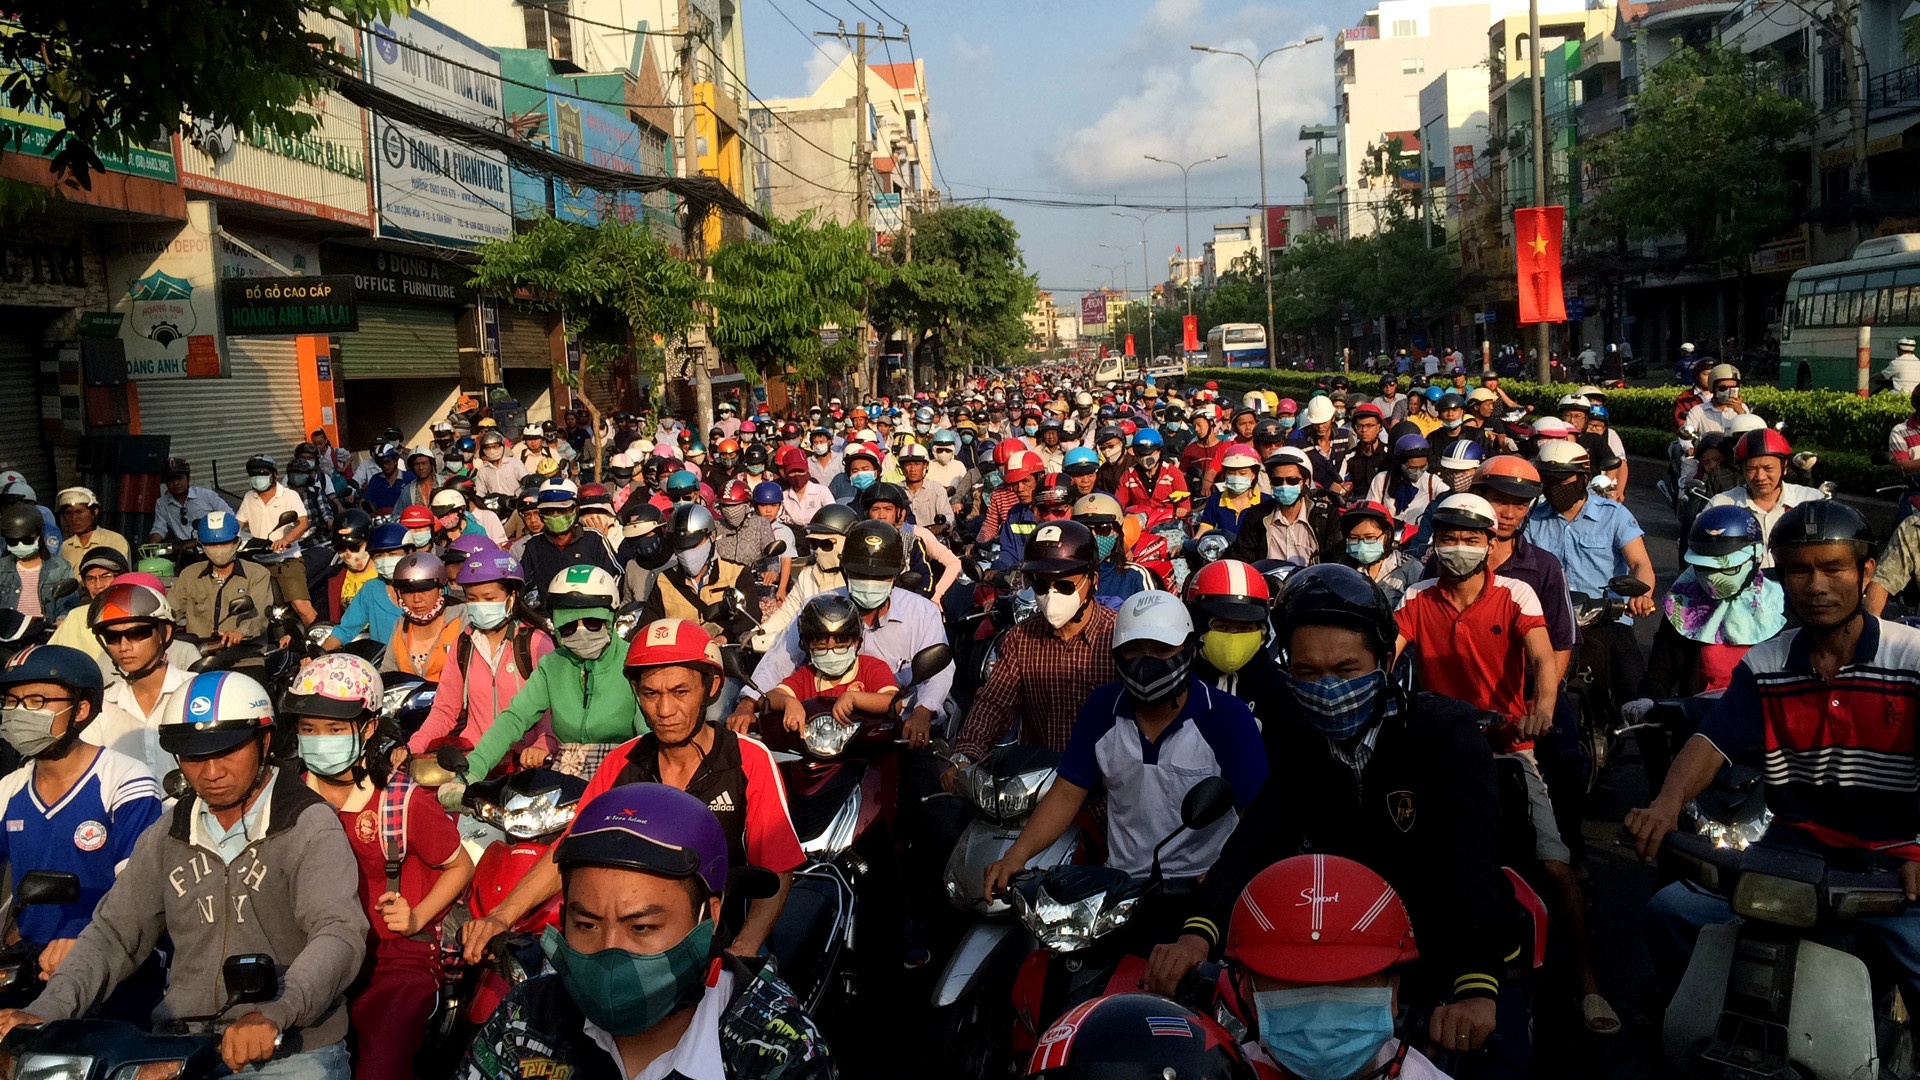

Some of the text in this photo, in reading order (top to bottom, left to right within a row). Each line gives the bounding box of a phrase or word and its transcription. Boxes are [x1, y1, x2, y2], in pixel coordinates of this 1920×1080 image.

[452, 151, 504, 193] FURNITURE
[175, 239, 210, 253] DEPOT
[283, 287, 306, 298] CAO
[309, 282, 332, 297] CẤP
[355, 275, 456, 299] OFFICE FURNITURE
[279, 305, 304, 326] ANH
[307, 304, 329, 325] GIA
[330, 304, 350, 325] LAI
[158, 359, 179, 374] ANH
[1137, 595, 1162, 608] NIKE
[708, 803, 735, 812] adidas
[511, 848, 537, 856] HONDA
[1295, 887, 1339, 907] Sport
